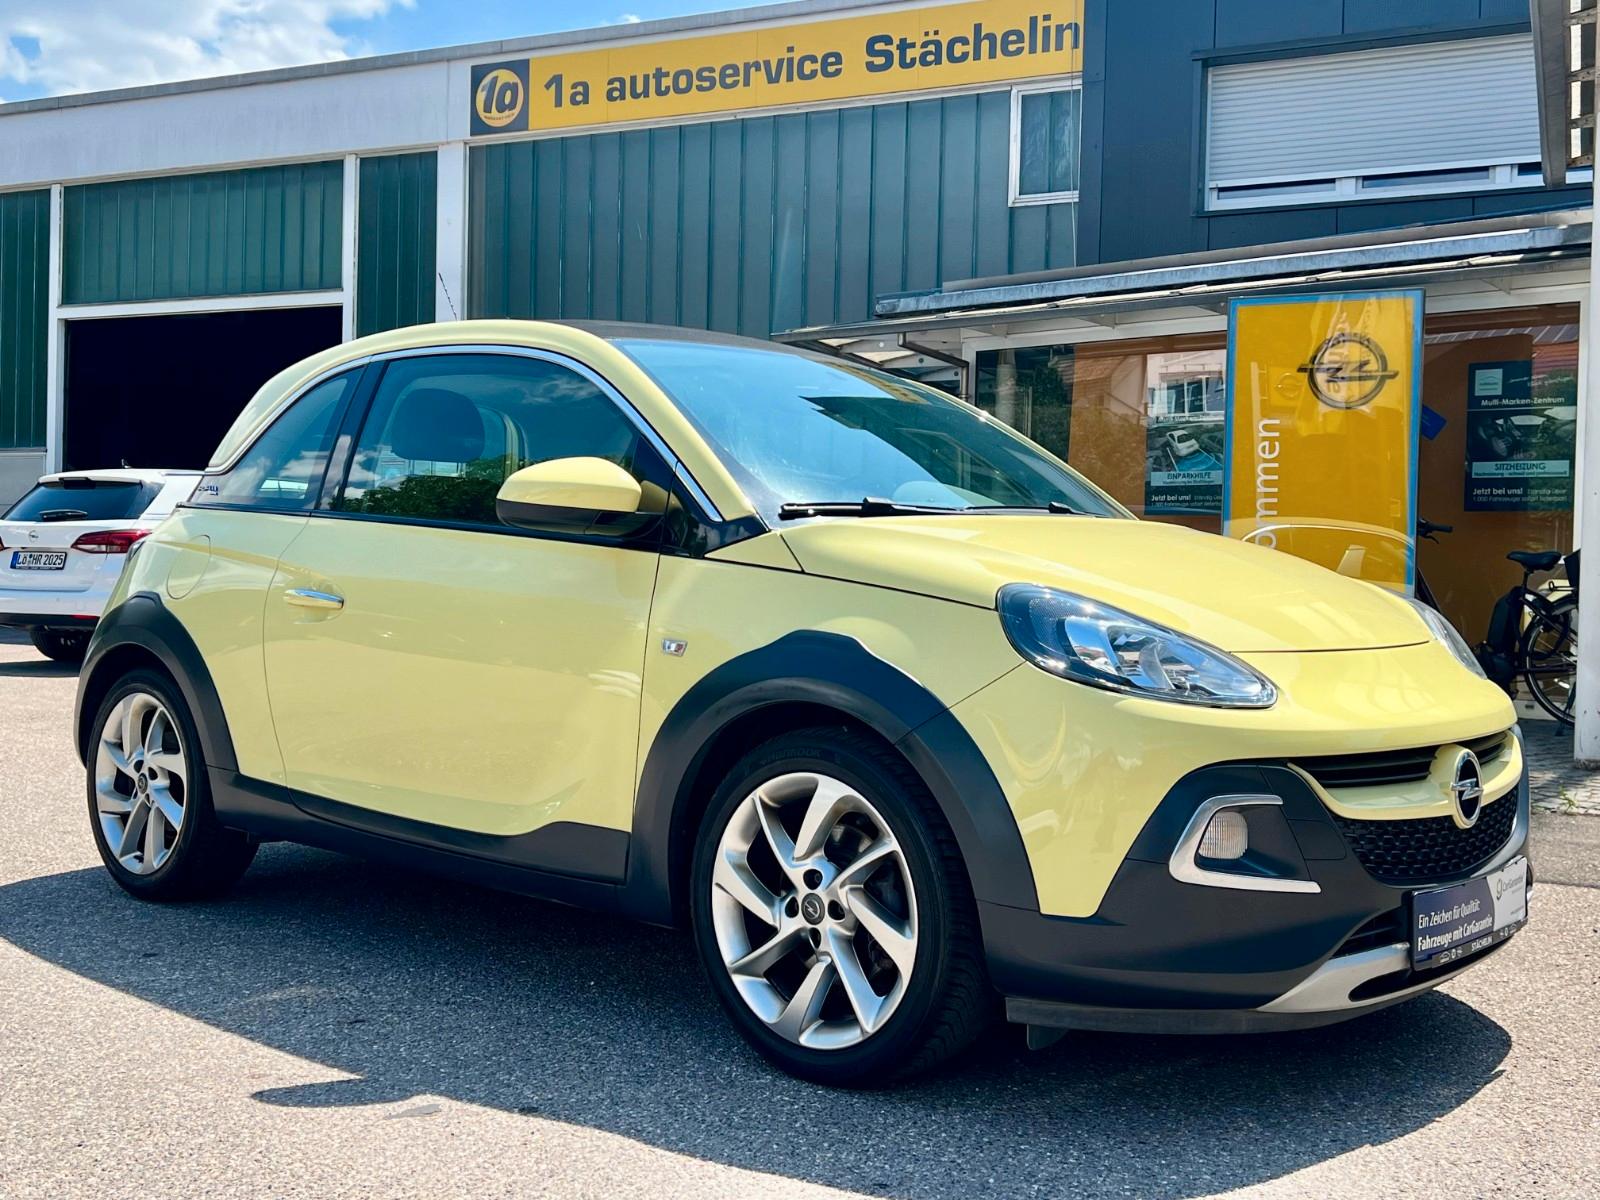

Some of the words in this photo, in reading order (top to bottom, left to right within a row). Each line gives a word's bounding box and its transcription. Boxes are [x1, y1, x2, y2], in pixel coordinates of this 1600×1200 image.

[544, 73, 590, 108] 1a
[606, 46, 843, 102] autoservice
[865, 14, 1080, 73] Stächelin
[1494, 462, 1547, 472] SITZHEIZUNG
[1473, 487, 1491, 496] Jetzt
[1492, 487, 1506, 496] bei
[43, 554, 64, 565] 2025
[1418, 914, 1429, 929] Ein
[1430, 909, 1453, 926] Zeichen
[1418, 933, 1453, 951] Fahrzeuge
[1453, 925, 1463, 941] mit
